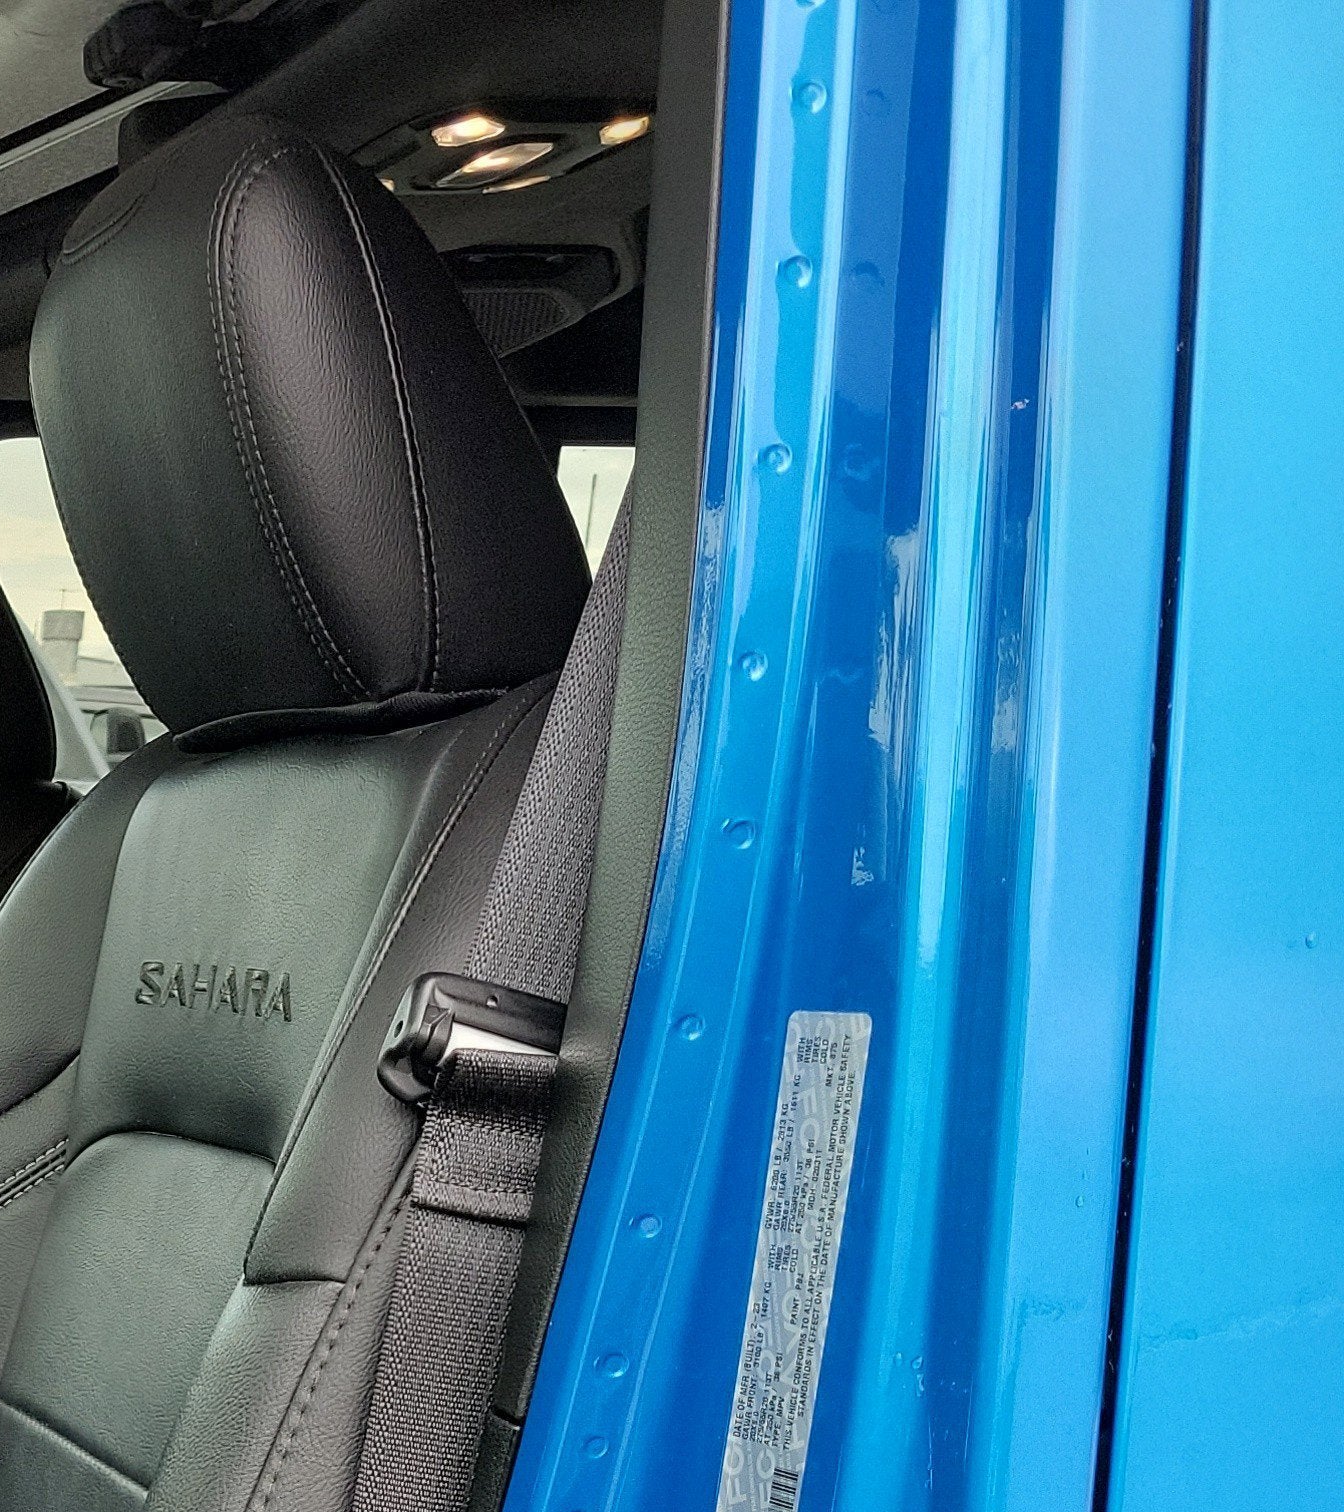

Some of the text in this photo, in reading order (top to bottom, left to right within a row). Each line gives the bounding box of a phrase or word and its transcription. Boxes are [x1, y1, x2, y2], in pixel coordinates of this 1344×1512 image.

[134, 961, 292, 1022] SAHARA
[840, 1034, 852, 1071] SAFETY
[834, 1074, 846, 1115] VEHICLE
[795, 1223, 803, 1234] AT
[819, 1039, 830, 1064] COLD
[828, 1119, 840, 1152] MOTOR
[838, 1109, 851, 1145] SHOWN
[821, 1156, 834, 1200] FEDERAL
[827, 1147, 845, 1221] MANUFACTURE
[824, 1224, 833, 1237] OF
[807, 1236, 822, 1294] APPLICABLE
[820, 1242, 831, 1266] DATE
[756, 1332, 764, 1344] LB
[767, 1244, 777, 1269] WITH
[816, 1267, 827, 1290] THE
[804, 1296, 813, 1315] ALL
[814, 1291, 823, 1305] ON
[801, 1317, 809, 1330] TO
[808, 1308, 820, 1343] EFFECT
[763, 1434, 771, 1447] AT
[775, 1352, 783, 1368] PSI
[789, 1248, 799, 1274] COLD
[793, 1333, 807, 1385] CONFORMS
[806, 1346, 815, 1356] IN
[739, 1375, 750, 1396] MFR
[797, 1359, 813, 1418] STANDARDS
[737, 1398, 747, 1411] OF
[776, 1396, 785, 1417] MPV
[787, 1387, 799, 1426] VEHICLE
[733, 1412, 745, 1438] DATE
[783, 1429, 792, 1452] THIS
